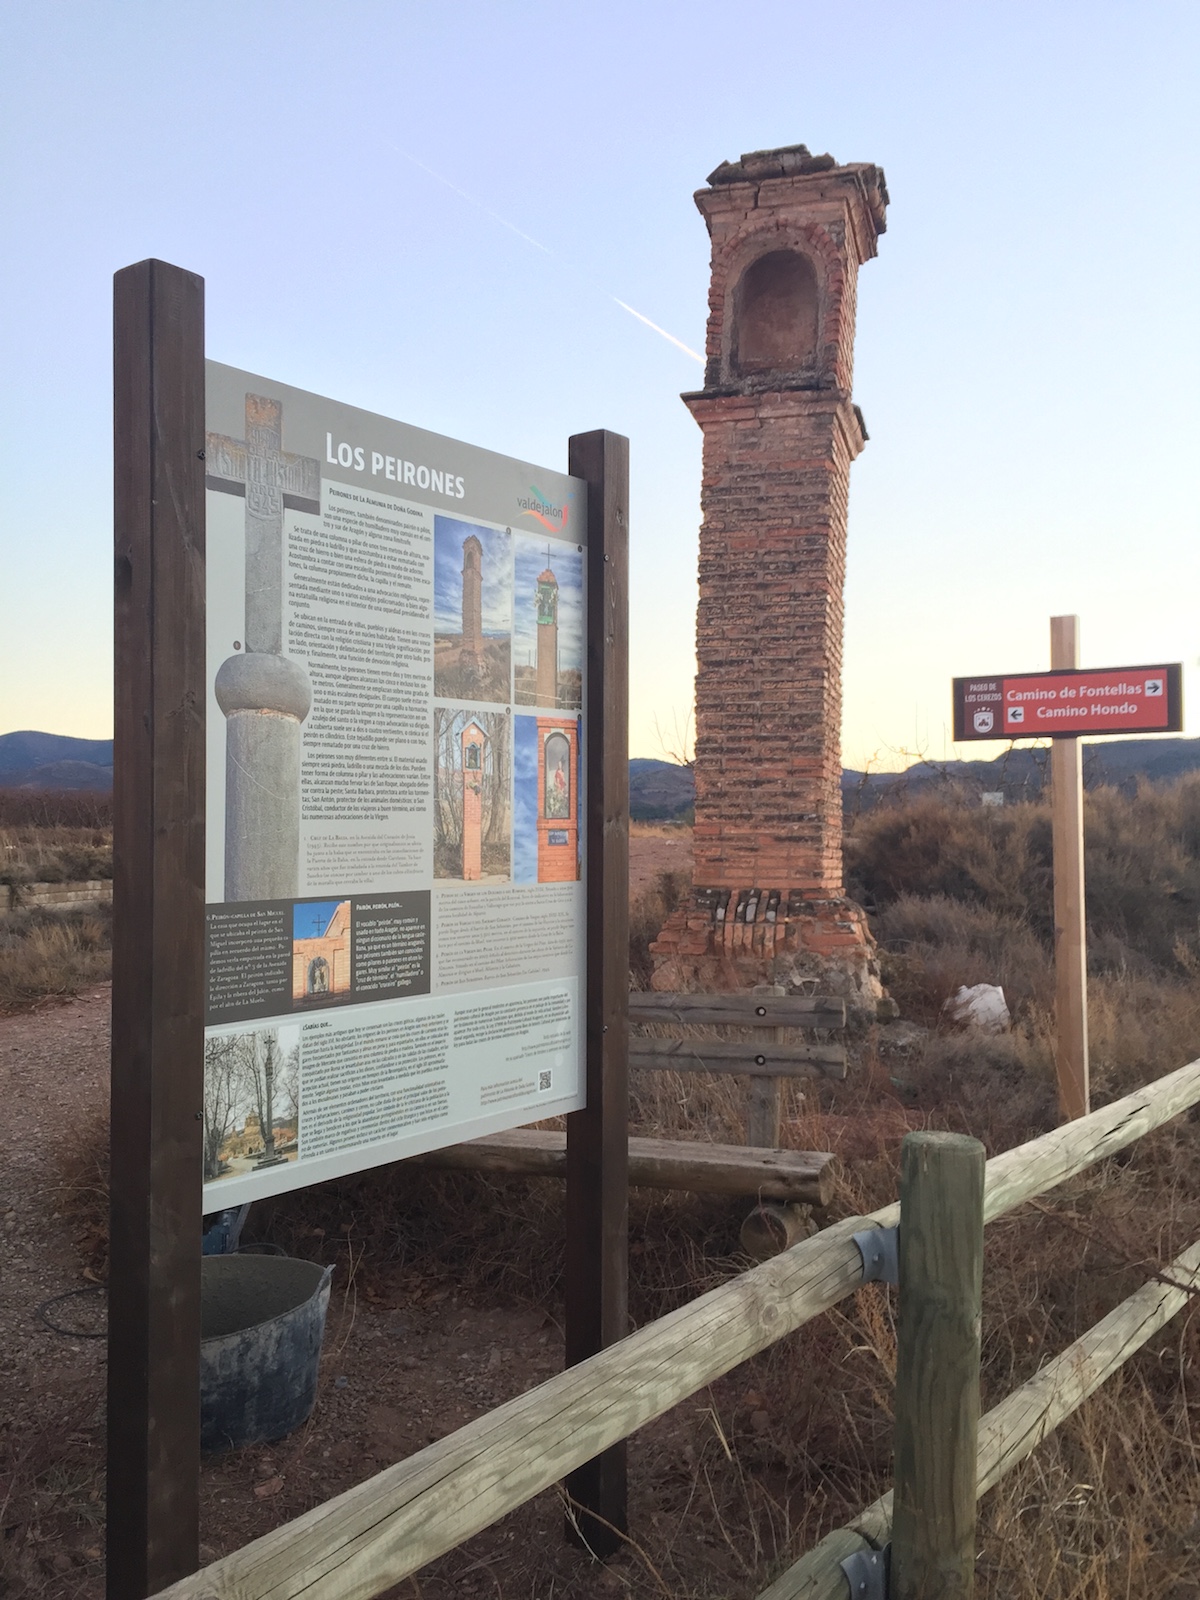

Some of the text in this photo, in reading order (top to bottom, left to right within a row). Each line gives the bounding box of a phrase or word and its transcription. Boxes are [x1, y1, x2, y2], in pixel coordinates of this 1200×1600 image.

[326, 432, 365, 472] LOS
[372, 452, 465, 498] PEIRONES
[329, 487, 351, 499] PEIRONES
[970, 684, 986, 692] PASEO
[1006, 684, 1142, 702] Camino de Fontellas
[965, 693, 1002, 702] LOS CEREZOS
[1036, 702, 1137, 718] Camino Hondo
